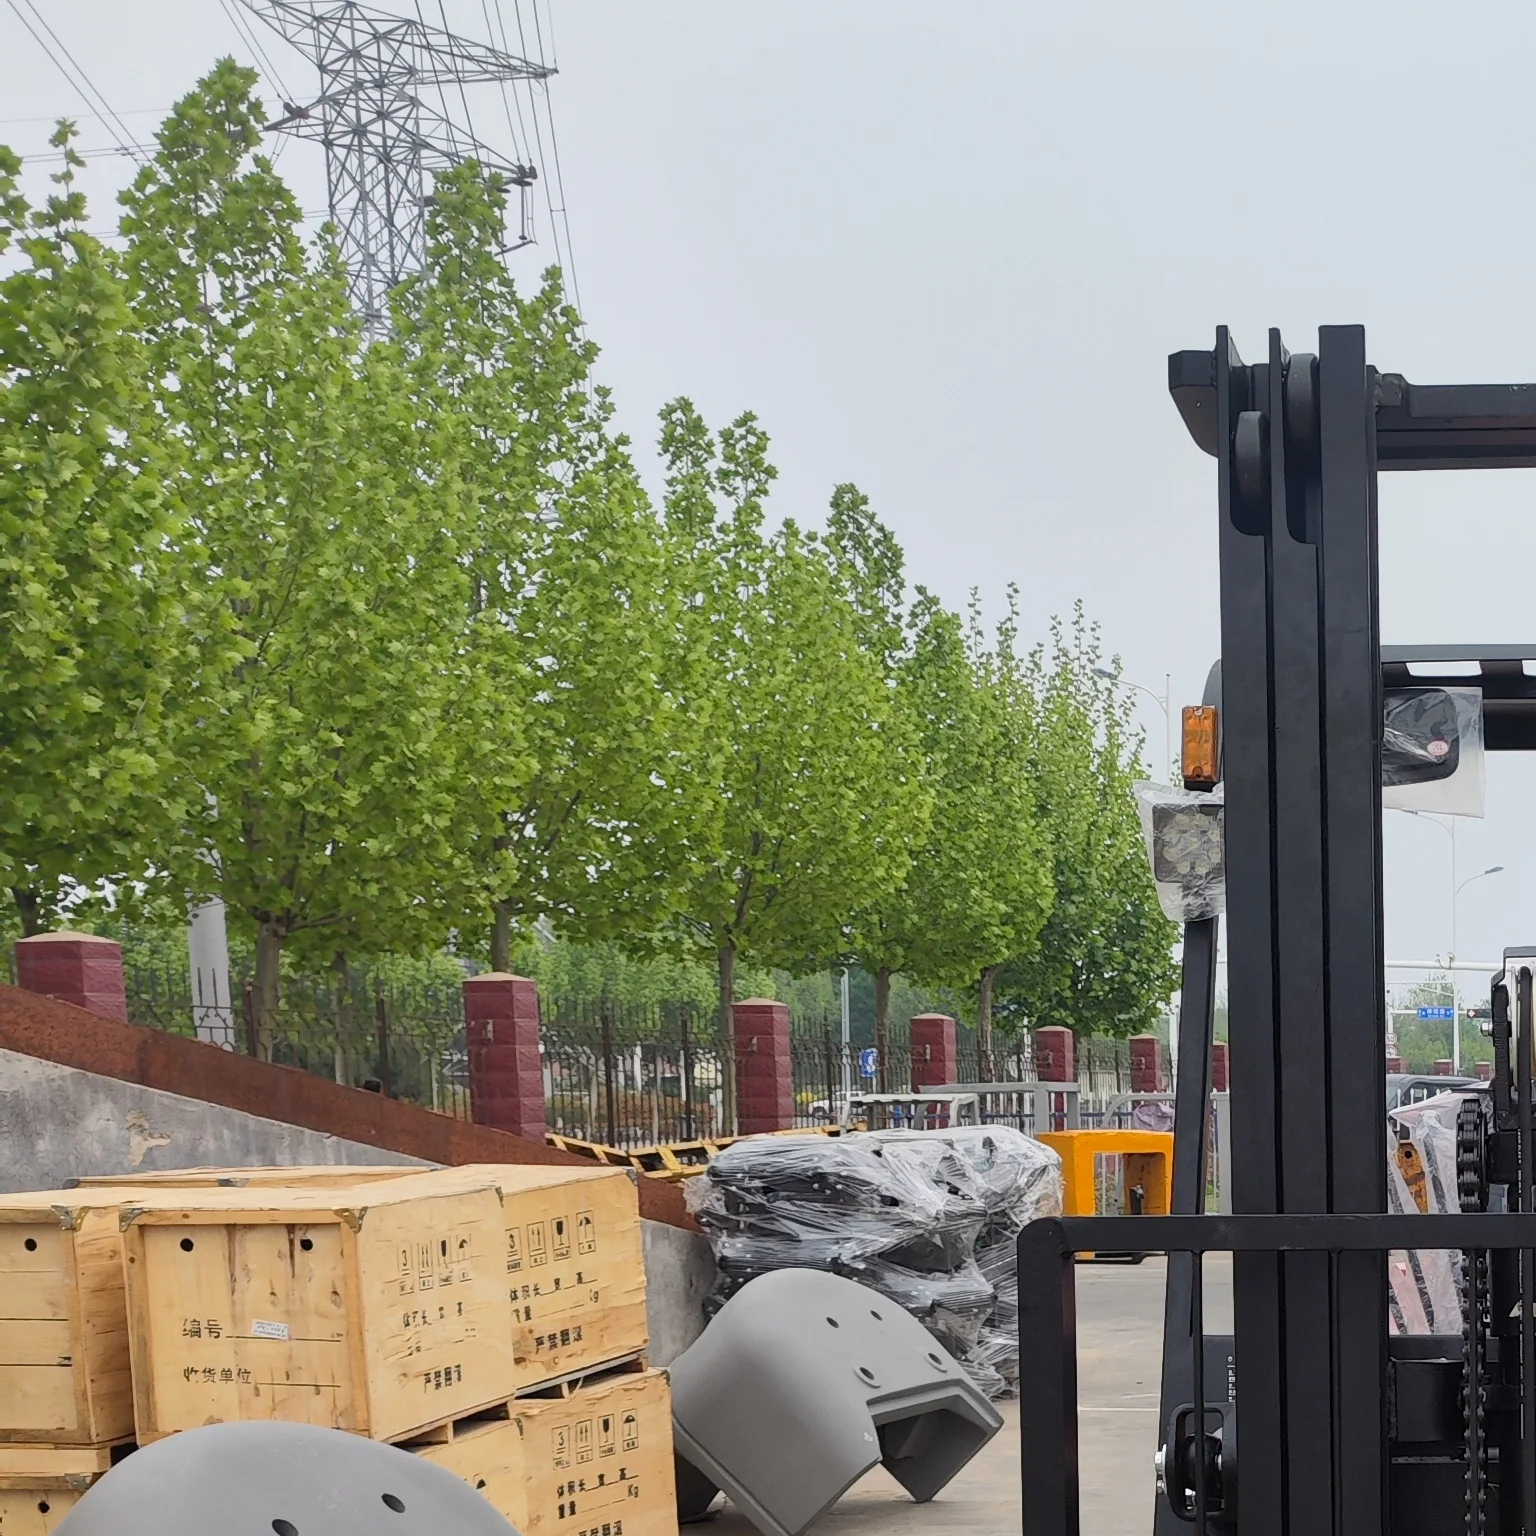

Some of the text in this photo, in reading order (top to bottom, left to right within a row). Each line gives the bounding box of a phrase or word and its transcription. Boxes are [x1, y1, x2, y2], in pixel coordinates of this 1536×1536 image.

[182, 1318, 223, 1339] 编号
[183, 1366, 252, 1385] 收货单位
